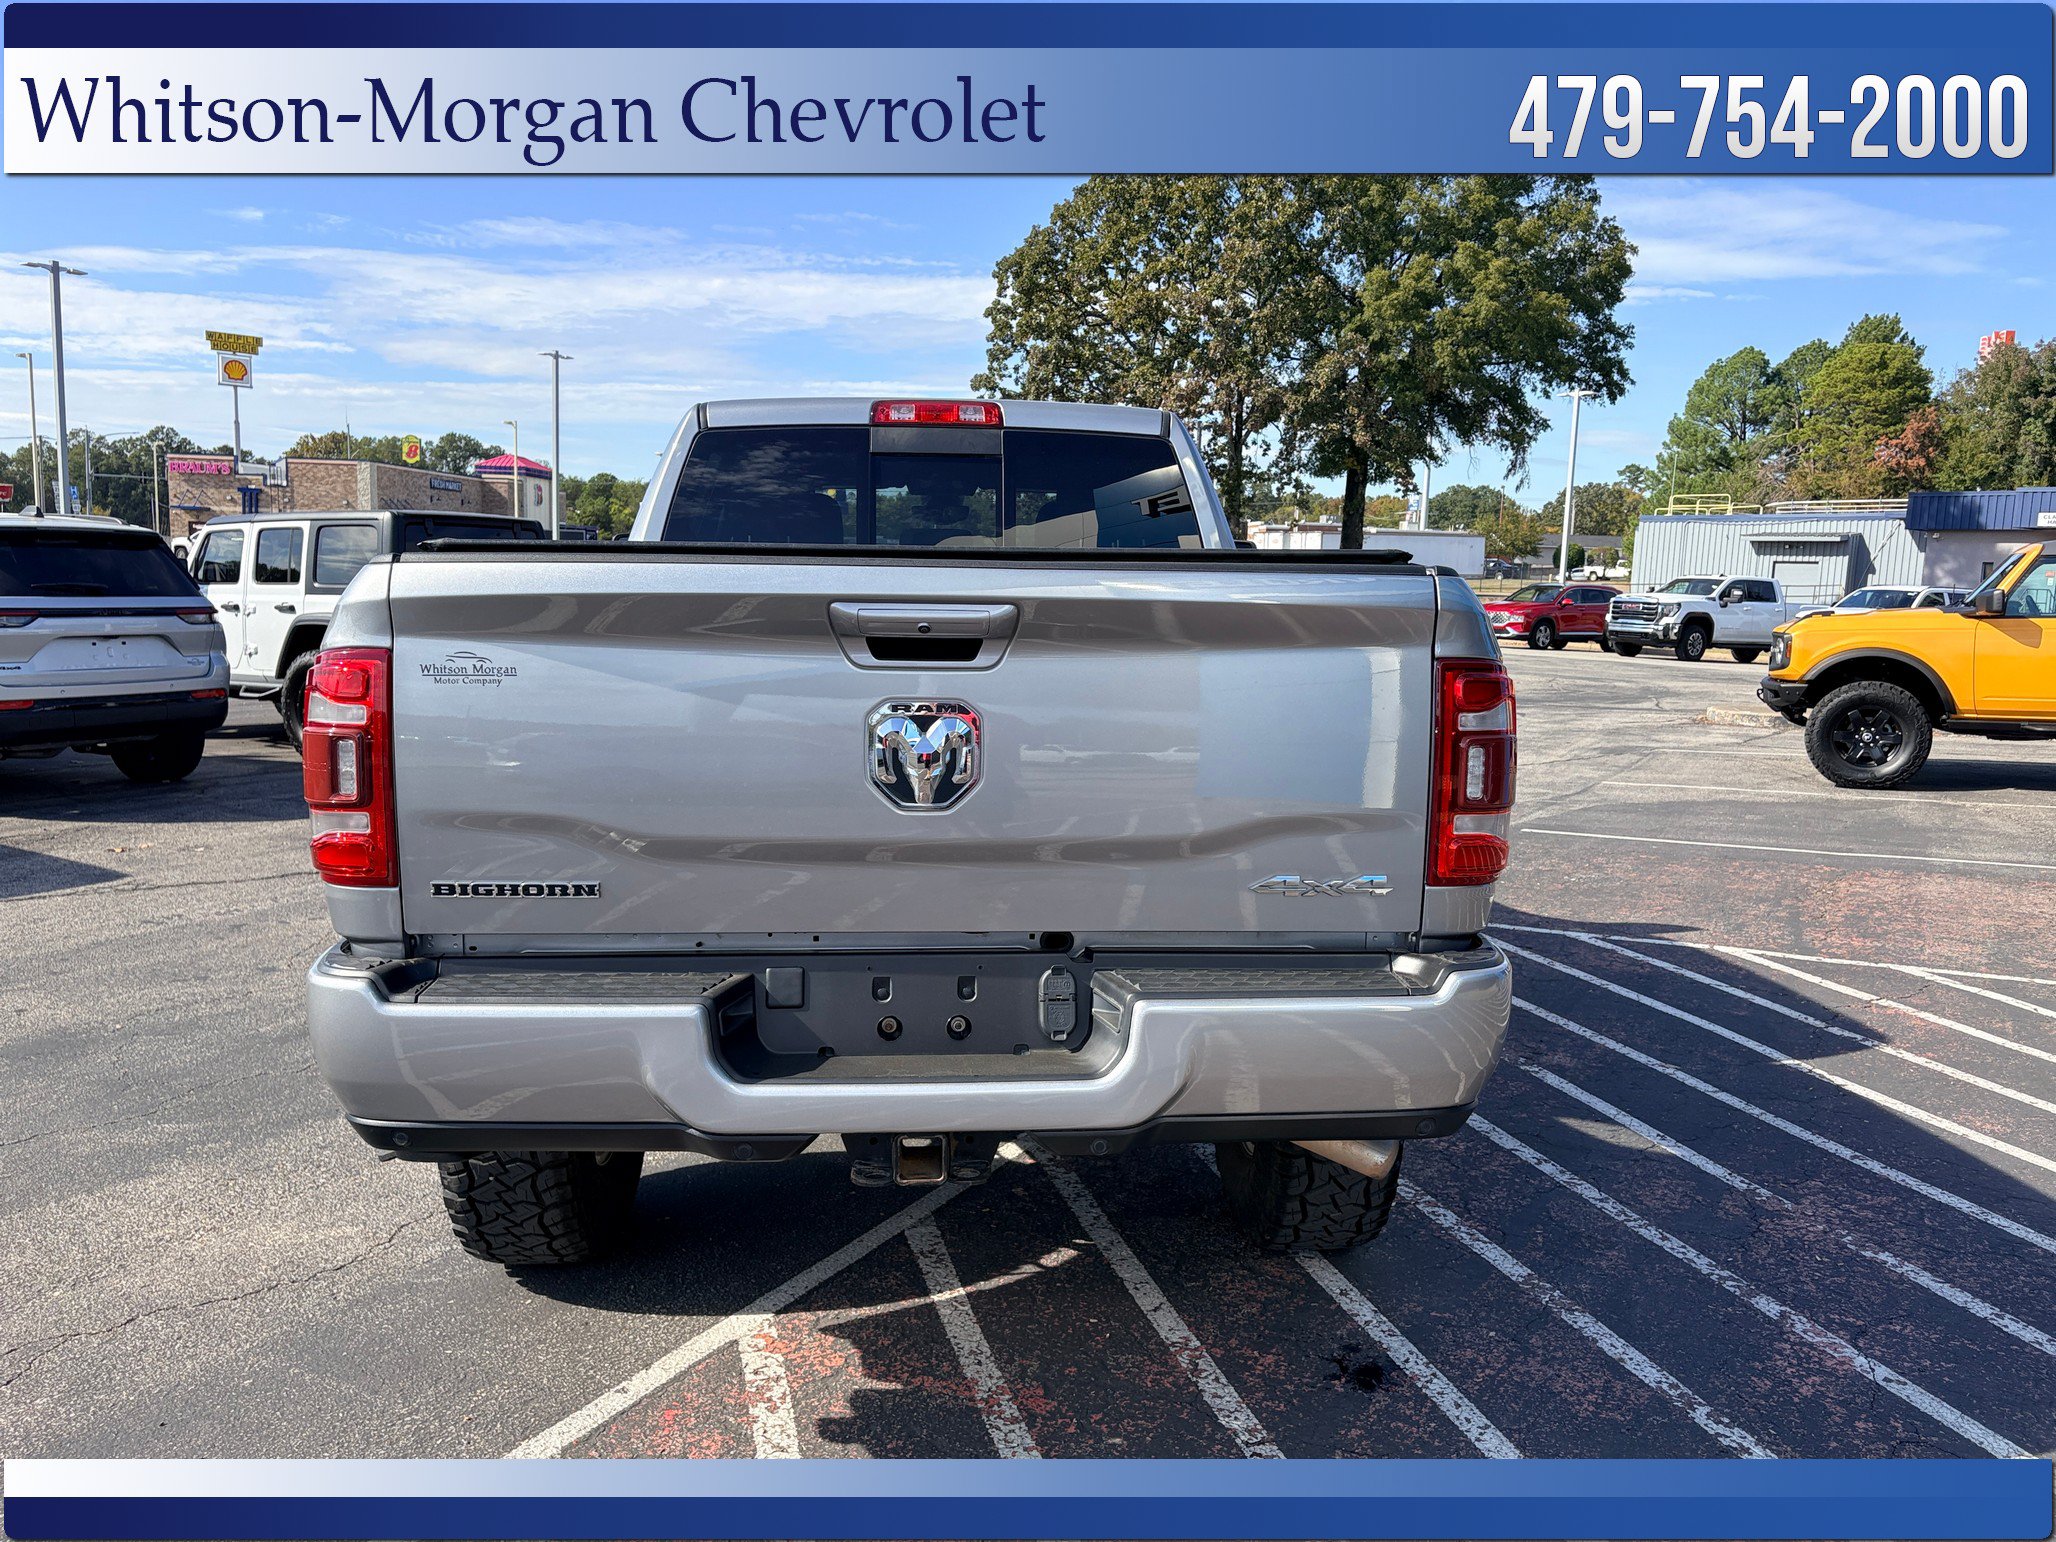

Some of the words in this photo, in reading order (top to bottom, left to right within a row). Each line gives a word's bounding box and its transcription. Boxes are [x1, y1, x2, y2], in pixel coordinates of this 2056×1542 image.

[207, 332, 262, 345] WAFFLE
[212, 341, 258, 353] HOUSE
[170, 461, 231, 474] BRAUM'S
[420, 663, 468, 675] Whitson
[472, 663, 517, 677] Morgan
[433, 677, 460, 685] Motor
[462, 676, 503, 687] Company
[891, 704, 957, 713] RAM
[430, 881, 601, 899] BIGHORN
[1248, 875, 1394, 897] 4x4
